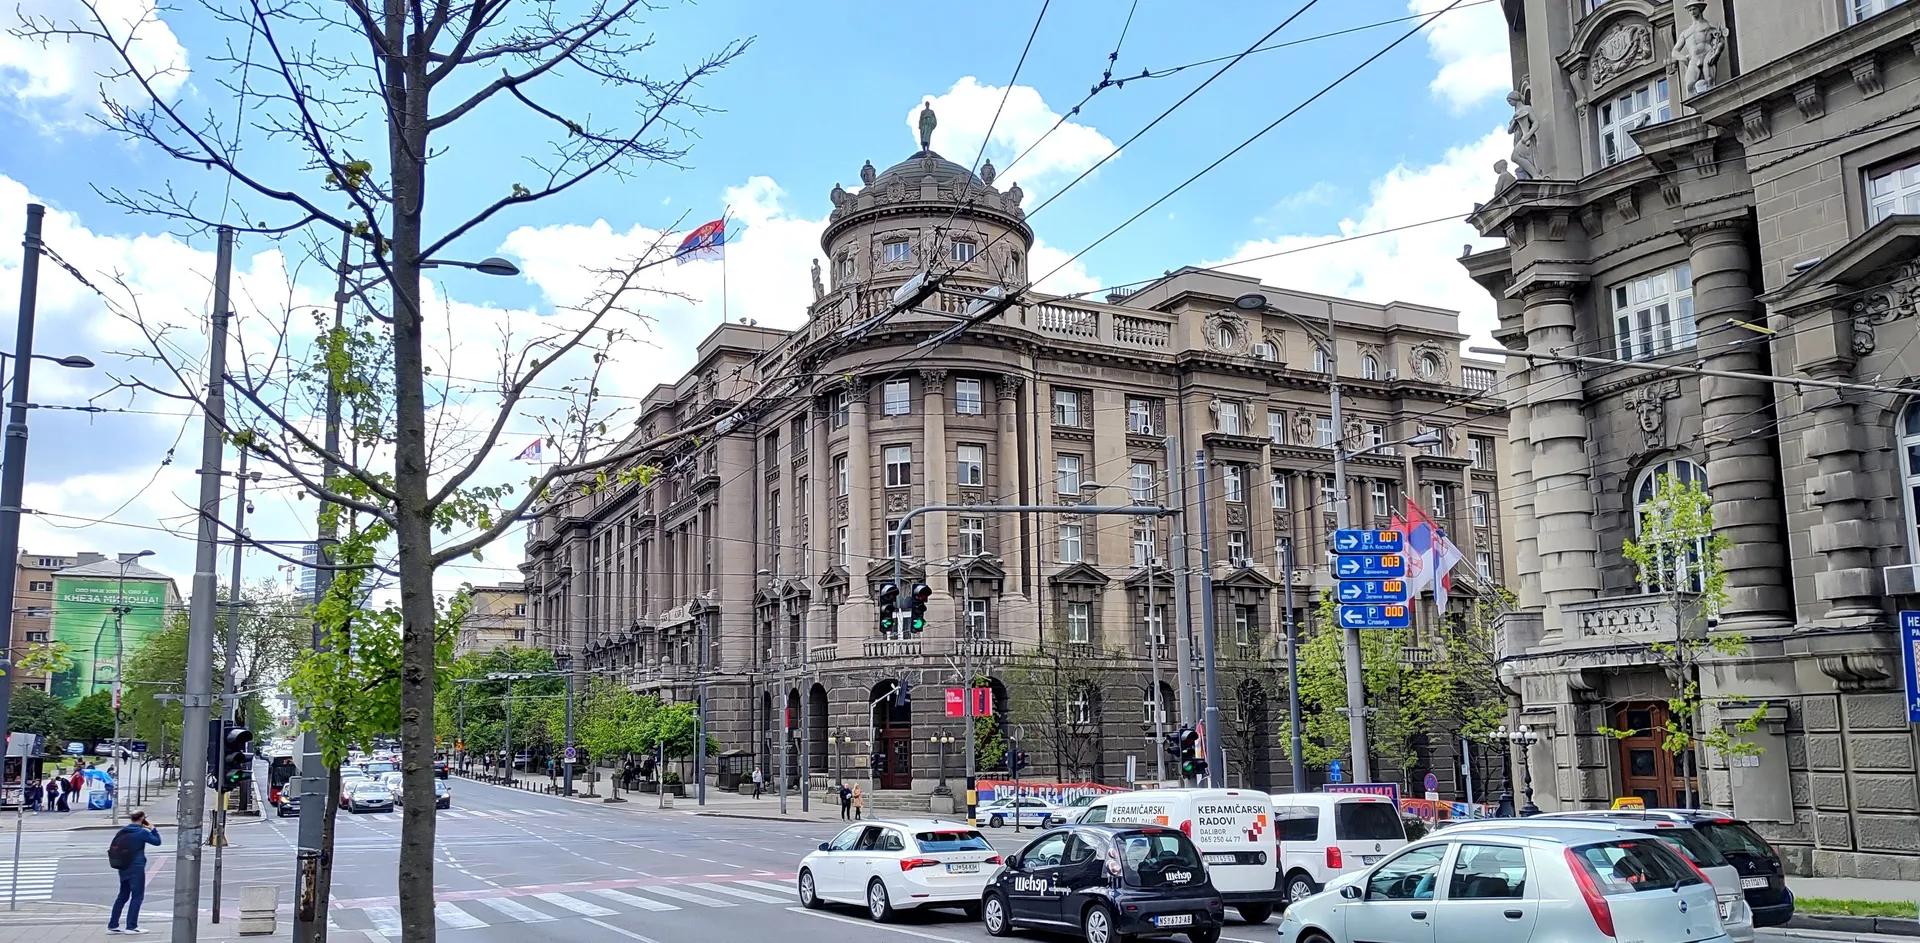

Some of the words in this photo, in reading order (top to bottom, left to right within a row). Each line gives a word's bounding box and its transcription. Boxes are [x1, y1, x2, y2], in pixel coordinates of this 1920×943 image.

[1381, 556, 1400, 567] 003
[1383, 581, 1402, 592] 000
[64, 594, 101, 602] КНЕЗА
[104, 595, 159, 604] МИЛОША!
[1385, 606, 1404, 617] 000
[1112, 804, 1166, 815] KERAMIČARSKI
[1197, 803, 1266, 814] KERAMIČARSKI
[1199, 816, 1236, 826] RADOVI
[1159, 916, 1167, 925] NS
